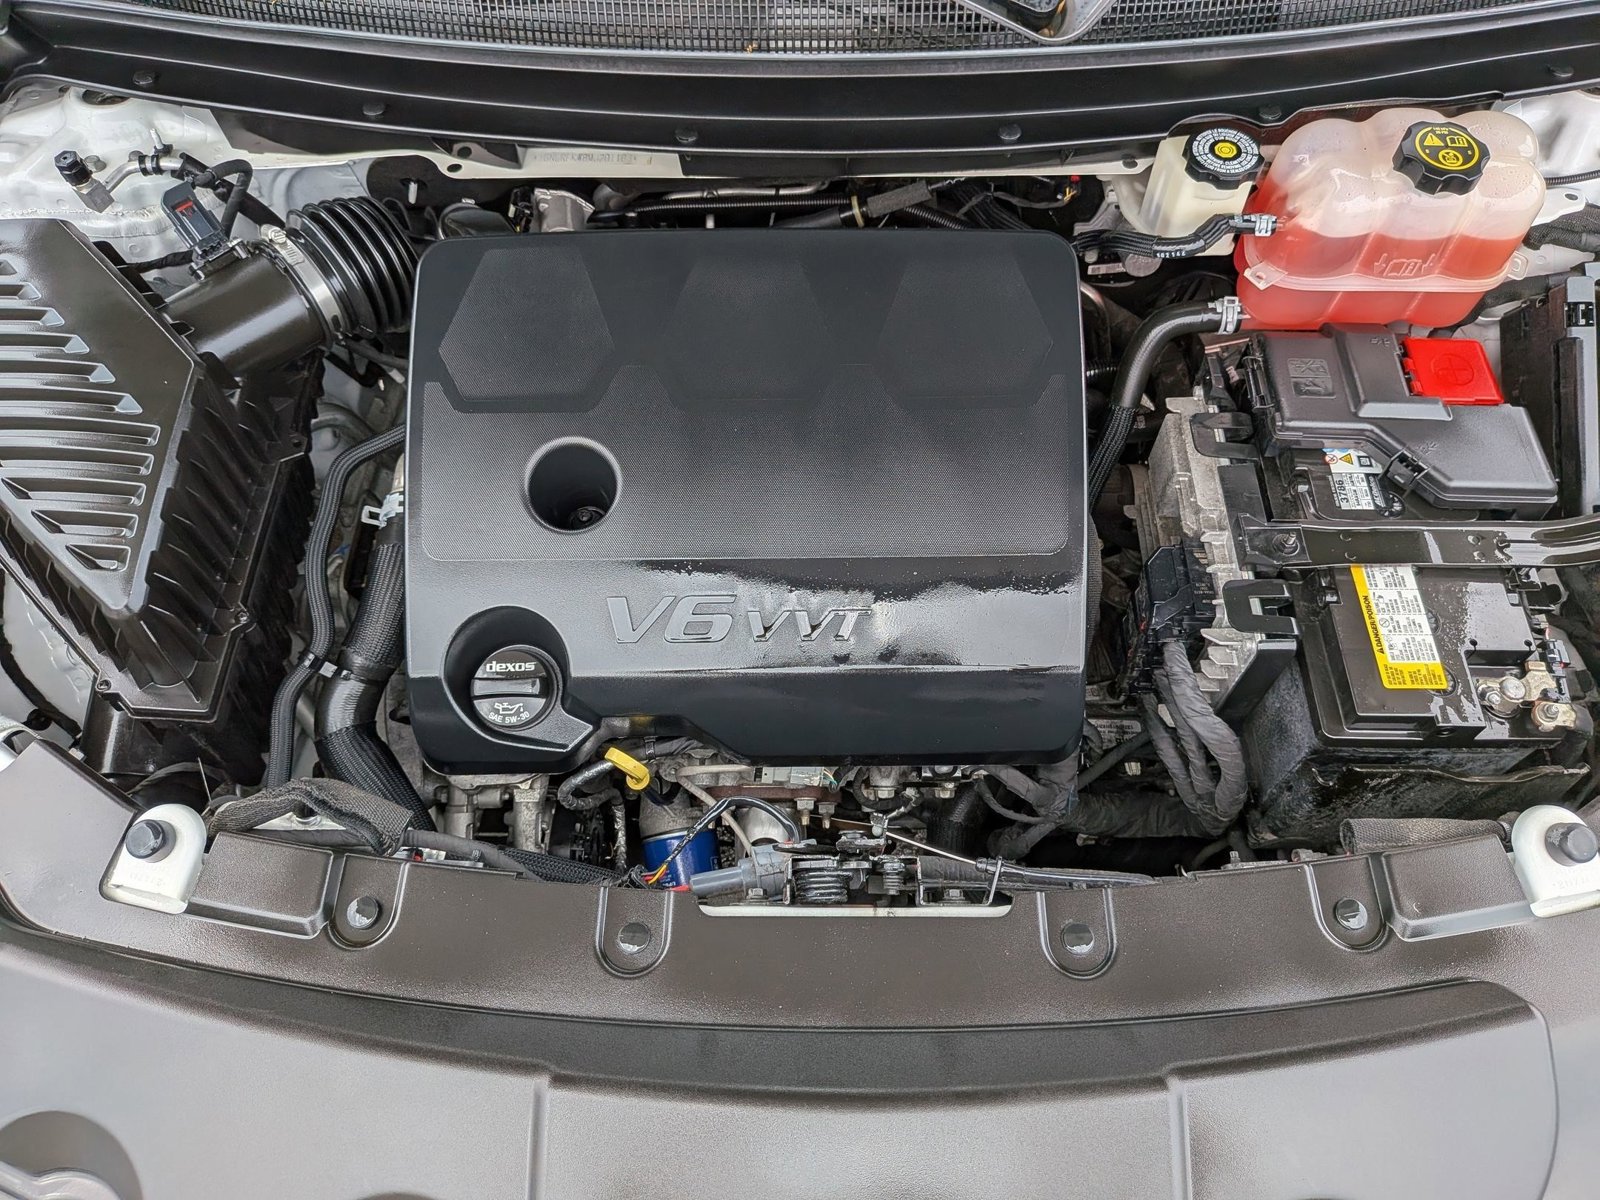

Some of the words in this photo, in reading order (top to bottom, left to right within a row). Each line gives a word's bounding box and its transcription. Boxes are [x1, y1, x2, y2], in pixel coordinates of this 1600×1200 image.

[1335, 480, 1349, 503] 3786
[606, 595, 738, 644] V6
[746, 606, 873, 643] VVT
[485, 660, 537, 672] dexos
[488, 711, 504, 723] SAE
[504, 711, 530, 724] 5W-30
